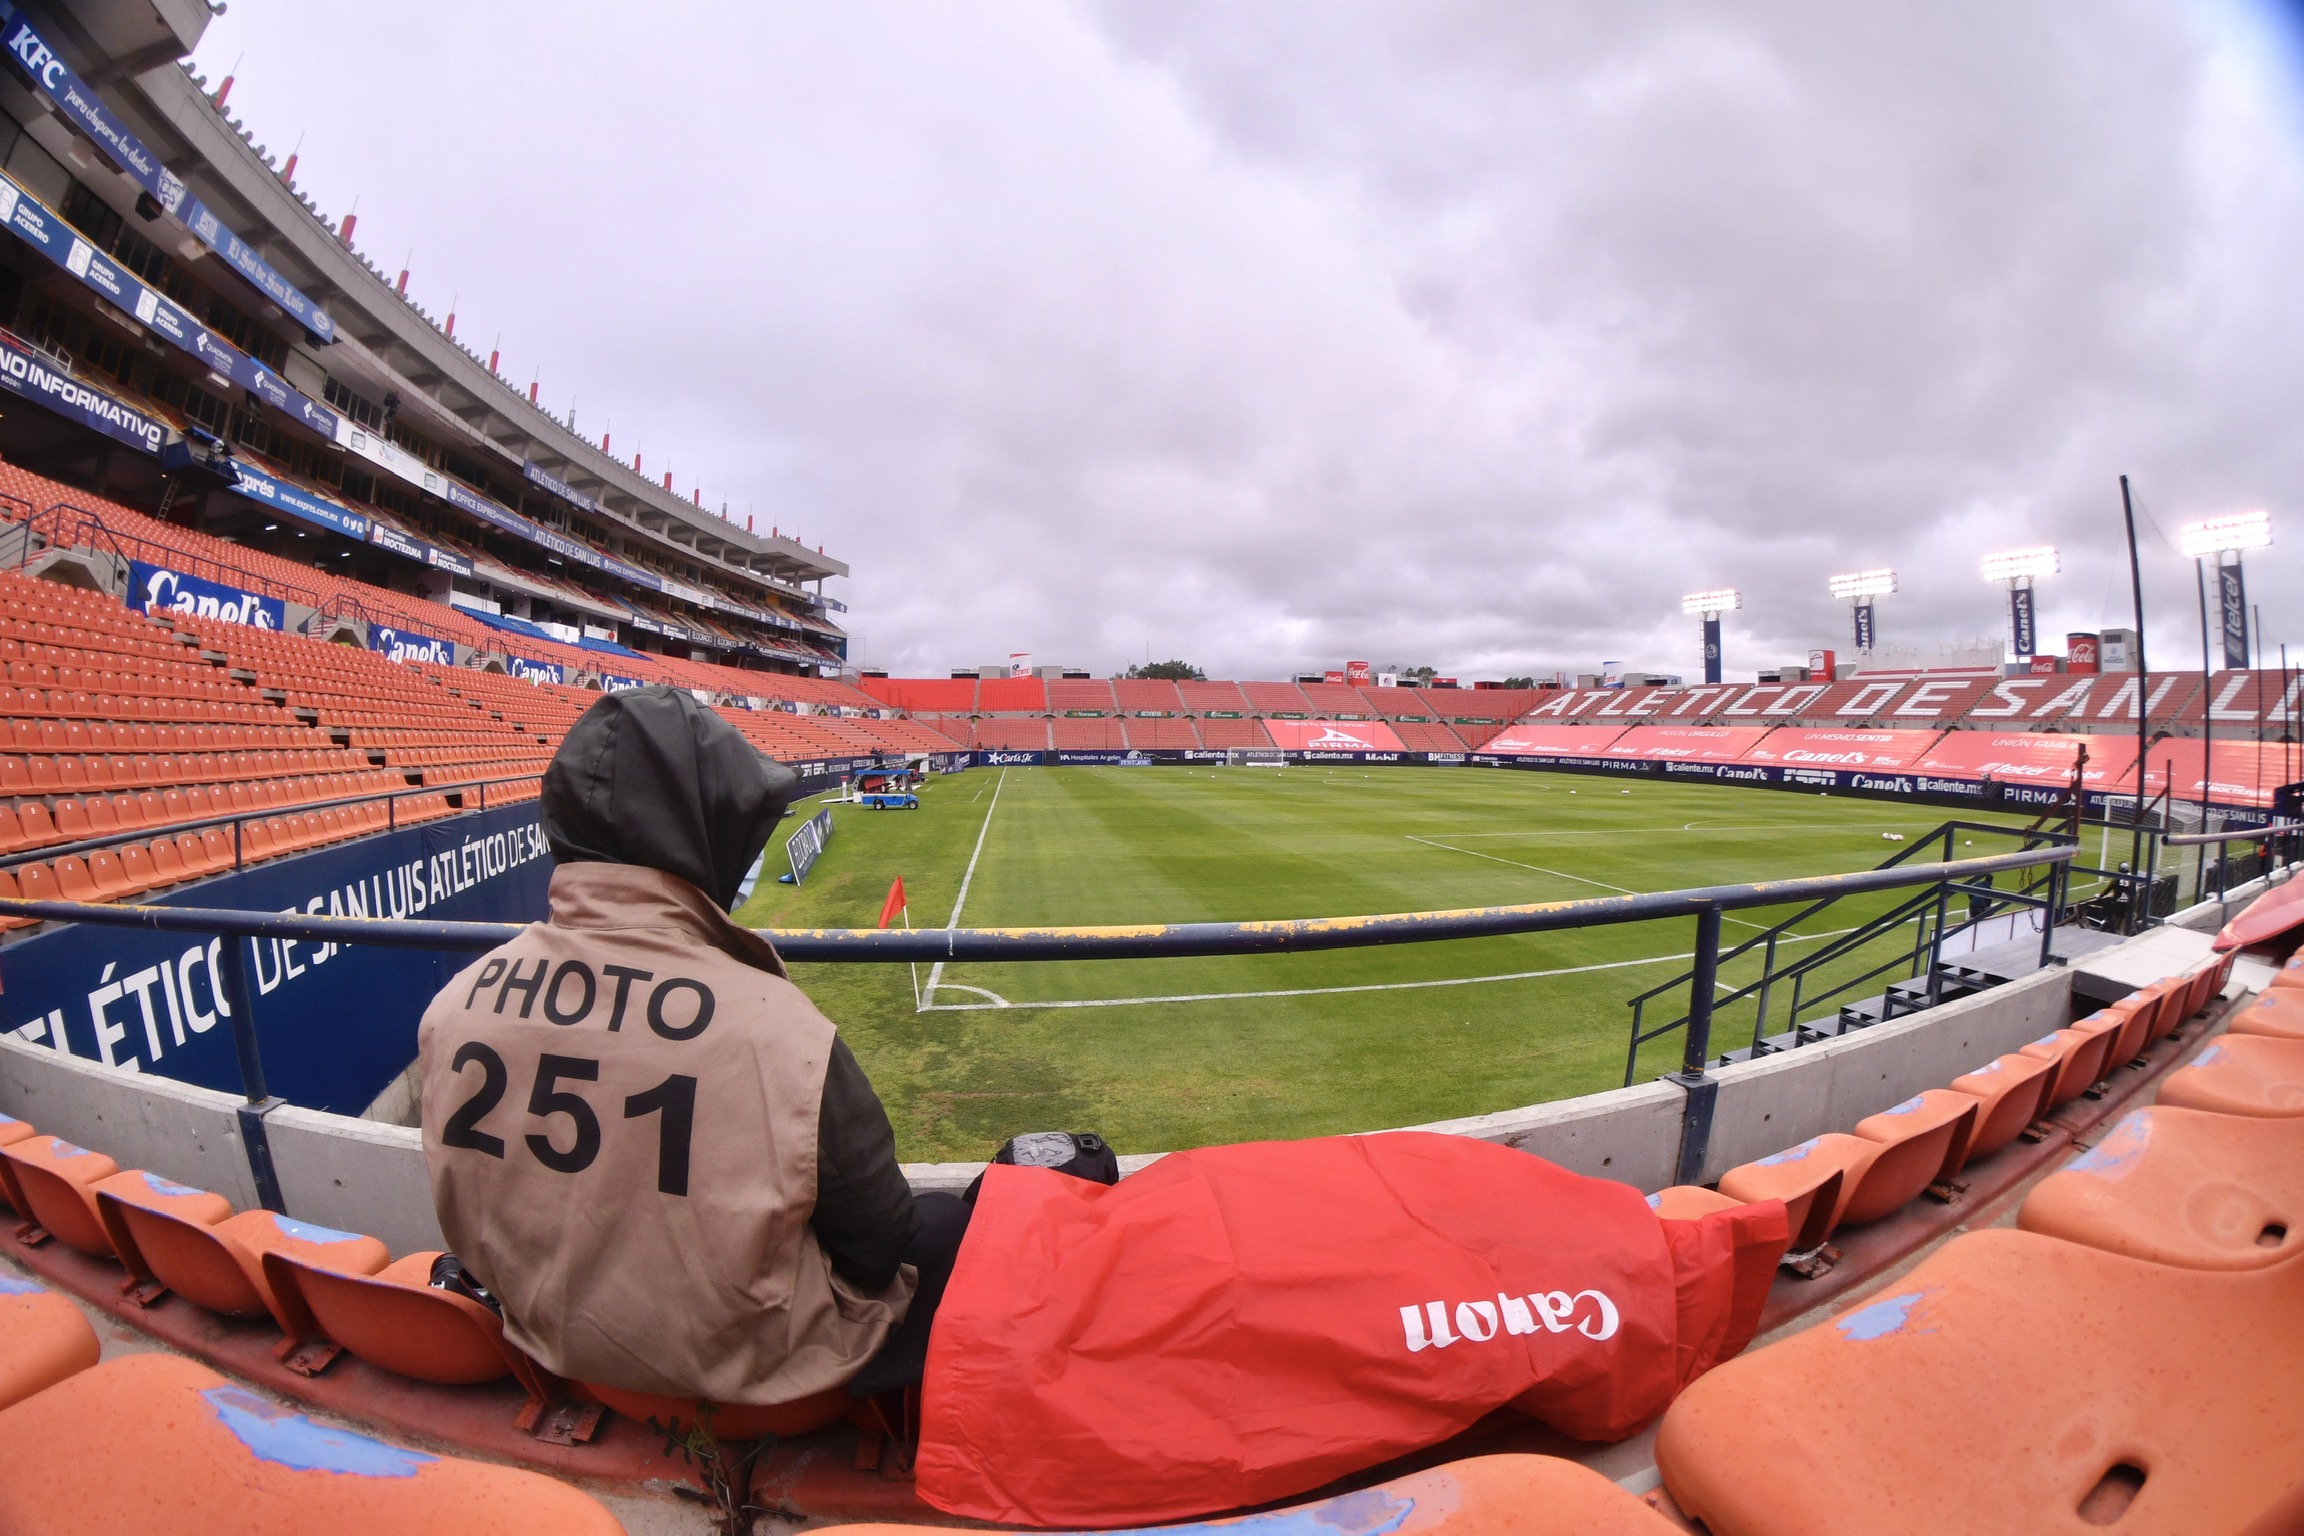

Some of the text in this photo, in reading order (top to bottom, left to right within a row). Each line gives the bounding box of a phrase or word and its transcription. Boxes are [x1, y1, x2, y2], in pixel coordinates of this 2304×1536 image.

[9, 24, 65, 90] KFC
[17, 203, 44, 228] GRUPO
[13, 214, 49, 244] ACERERO
[92, 259, 115, 281] GRUPO
[88, 269, 121, 295] ACERERO
[238, 249, 258, 275] Sol
[255, 264, 267, 284] de
[264, 273, 284, 298] San
[283, 286, 305, 314] Luis
[157, 306, 178, 326] GRUPO
[154, 317, 183, 339] ACERERO
[206, 343, 234, 365] QUADRATIN
[263, 380, 288, 399] QUADRATIN
[28, 363, 161, 444] INFORMATIVO
[311, 410, 333, 428] QUADRATIN
[530, 467, 591, 510] ATLÉTICO DE SAN LUIS
[280, 492, 339, 523] www.expres.com.mx
[456, 492, 476, 511] OFFICE
[476, 500, 497, 520] EXPRES
[384, 529, 406, 543] Cementos
[383, 536, 422, 559] MOCTEZUMA
[534, 529, 601, 568] ATLÉTICO DE SAN LUIS
[437, 558, 472, 577] MOCTEZUMA
[145, 570, 271, 631] Canel's
[2221, 571, 2243, 638] telcel
[1857, 608, 1869, 648] anel's
[2017, 591, 2030, 653] Canel's
[379, 628, 449, 666] Canel's
[512, 657, 560, 687] Canel's
[1836, 681, 1972, 717] DE
[1970, 676, 2178, 719] SAN
[1308, 741, 1374, 749] PIRMA
[1688, 730, 1730, 738] ORGULLO
[1822, 733, 1853, 742] MISMO
[1854, 734, 1893, 742] SENTIR
[1000, 752, 1021, 764] Carl's
[1070, 753, 1099, 761] Hospitales
[1193, 751, 1240, 759] caliente.mx
[1311, 752, 1354, 760] caliente.mx
[1365, 753, 1399, 761] Mobil
[1602, 760, 1637, 770] PIRMA
[1782, 749, 1869, 764] Canel's
[1673, 762, 1714, 774] caliente.mx
[1783, 768, 1836, 786] ESPN
[1993, 763, 2053, 776] telcel
[2061, 768, 2107, 781] Mbil
[1927, 780, 1983, 795] caliente.mx
[2004, 788, 2059, 805] PIRMA
[2230, 810, 2248, 822] SAN
[373, 858, 427, 920] LUIS
[430, 835, 507, 905] ATLÉTICO
[508, 827, 527, 868] DE
[464, 958, 716, 1041] PHOTO
[441, 1041, 698, 1197] 251
[1399, 1287, 1620, 1354] Canon
